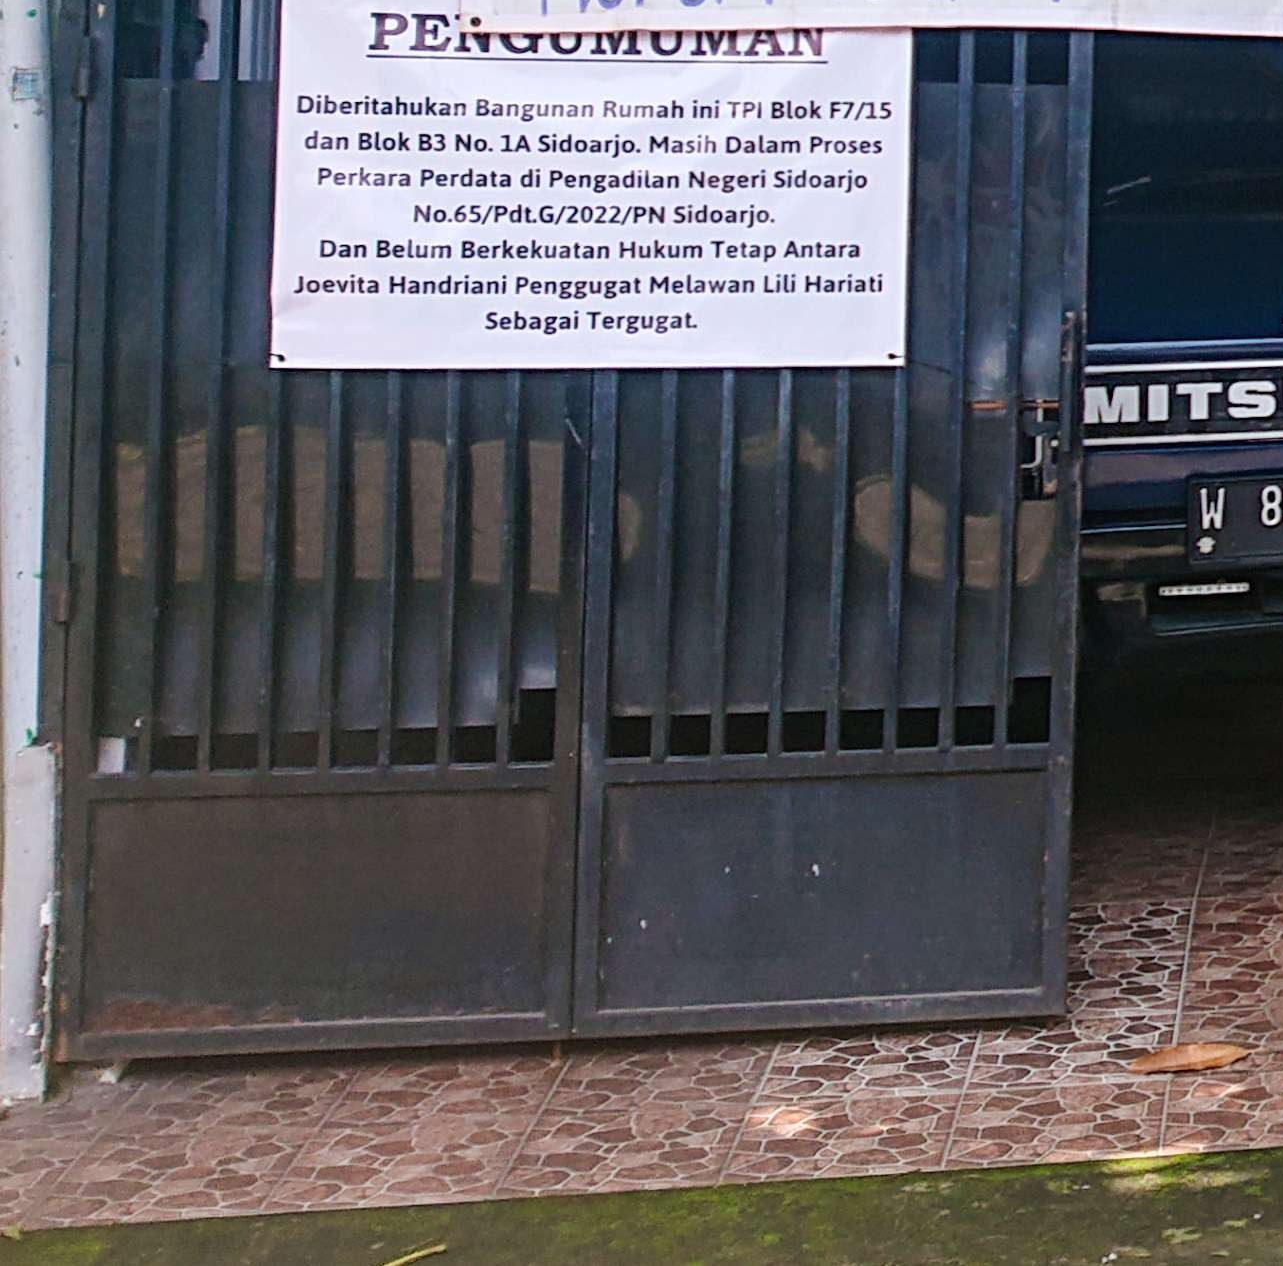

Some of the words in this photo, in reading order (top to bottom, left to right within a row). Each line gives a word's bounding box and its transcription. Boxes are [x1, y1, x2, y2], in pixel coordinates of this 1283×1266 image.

[295, 96, 467, 117] Diberitahukan
[476, 98, 594, 120] Bangunan
[603, 99, 684, 119] Rumah
[692, 100, 720, 119] ini
[727, 101, 762, 119] TPI
[771, 100, 822, 120] Blok
[829, 101, 892, 121] F7/15
[304, 132, 349, 151] dan
[358, 132, 411, 152] Blok
[418, 134, 446, 152] B3
[454, 134, 494, 153] No.
[500, 134, 530, 153] 1A
[537, 134, 641, 159] Sidoarjo.
[649, 135, 717, 155] Masih
[725, 135, 802, 155] Dalam
[809, 136, 883, 155] Proses
[317, 167, 411, 187] Perkara
[419, 169, 512, 188] Perdata
[519, 169, 541, 189] di
[548, 169, 680, 193] Pengadilan
[689, 170, 766, 193] Negeri
[774, 170, 869, 194] Sidoarjo
[674, 205, 776, 230] Sidoarjo.
[319, 239, 367, 259] Dan
[376, 240, 452, 260] Belum
[460, 240, 611, 260] Berkekuatan
[618, 240, 702, 260] Hukum
[710, 241, 776, 263] Tetap
[783, 241, 860, 260] Antara
[294, 274, 380, 295] Joevita
[388, 275, 508, 295] Handriani
[516, 276, 641, 300] Penggugat
[649, 276, 755, 295] Melawan
[763, 275, 797, 295] Lili
[805, 276, 883, 295] Hariati
[485, 311, 580, 336] Sebagai
[587, 311, 698, 336] Tergugat.
[1200, 487, 1226, 530] W
